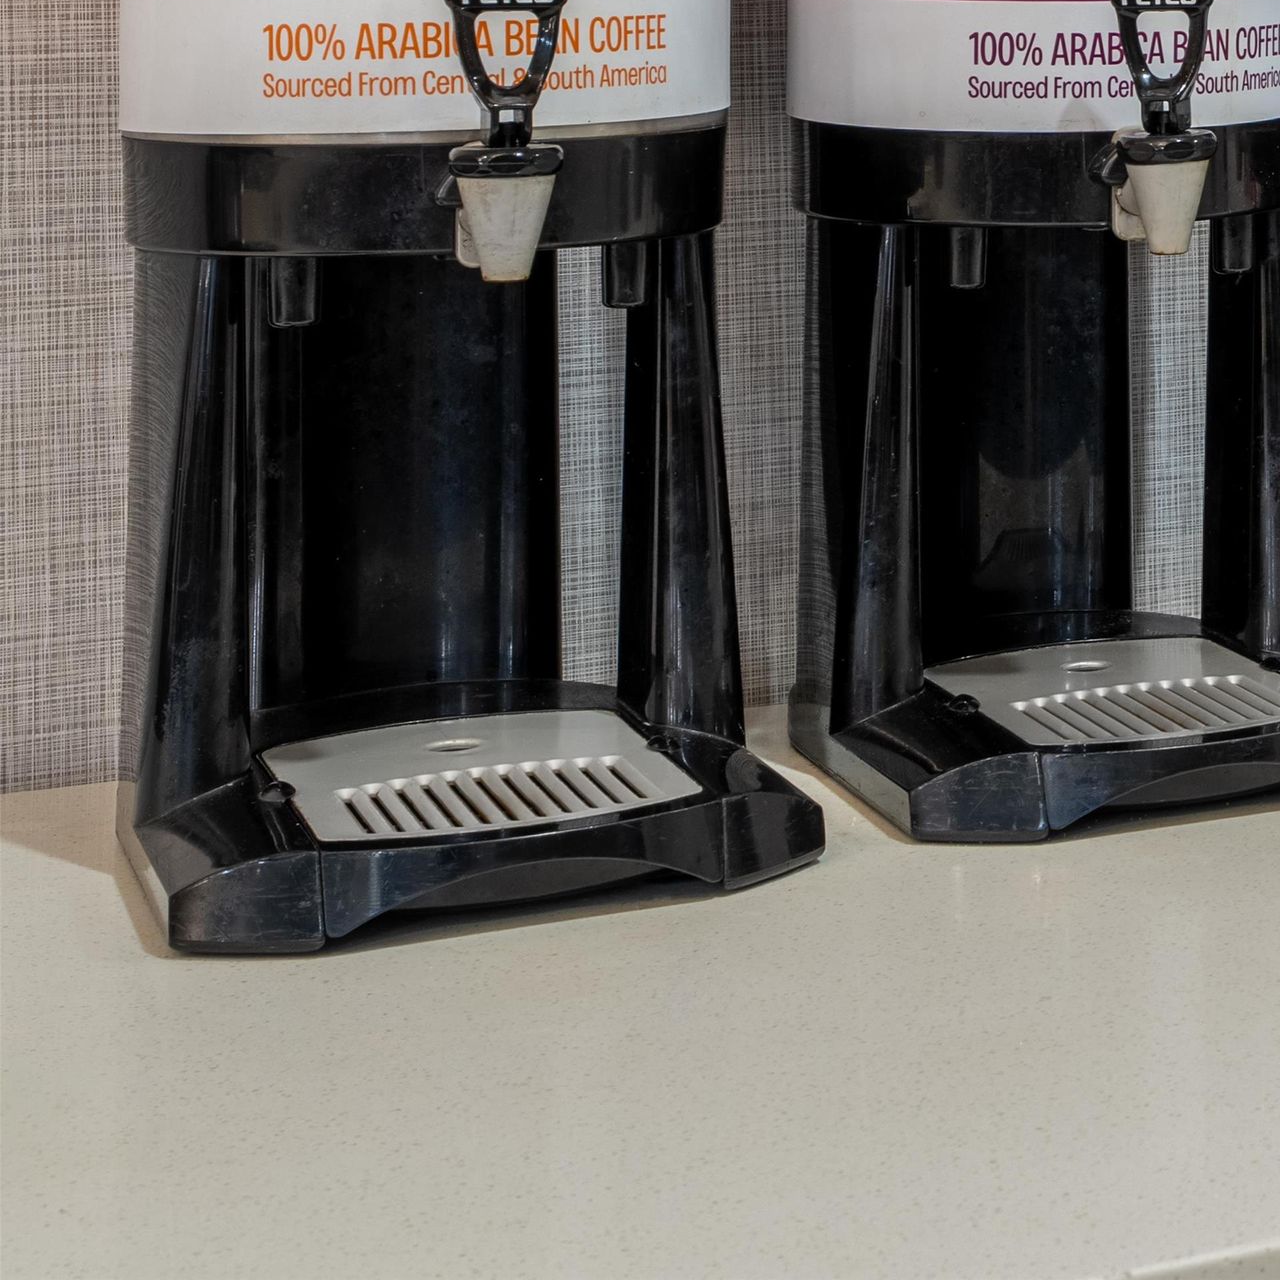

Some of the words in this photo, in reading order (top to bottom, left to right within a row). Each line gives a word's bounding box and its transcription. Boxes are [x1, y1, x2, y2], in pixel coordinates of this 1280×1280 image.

[263, 23, 346, 61] 100%
[355, 21, 494, 60] ARABIA
[506, 18, 579, 56] BEN
[589, 14, 667, 53] COFFEE
[969, 31, 1043, 66] 100%
[1051, 31, 1165, 66] ARABA
[1173, 28, 1229, 63] BAN
[263, 72, 352, 98] Sourced
[359, 72, 416, 97] From
[423, 68, 504, 96] Cenl
[542, 64, 595, 91] outh
[600, 61, 667, 88] America
[968, 76, 1048, 99] Sourced
[1054, 76, 1102, 99] From
[1195, 70, 1239, 95] South
